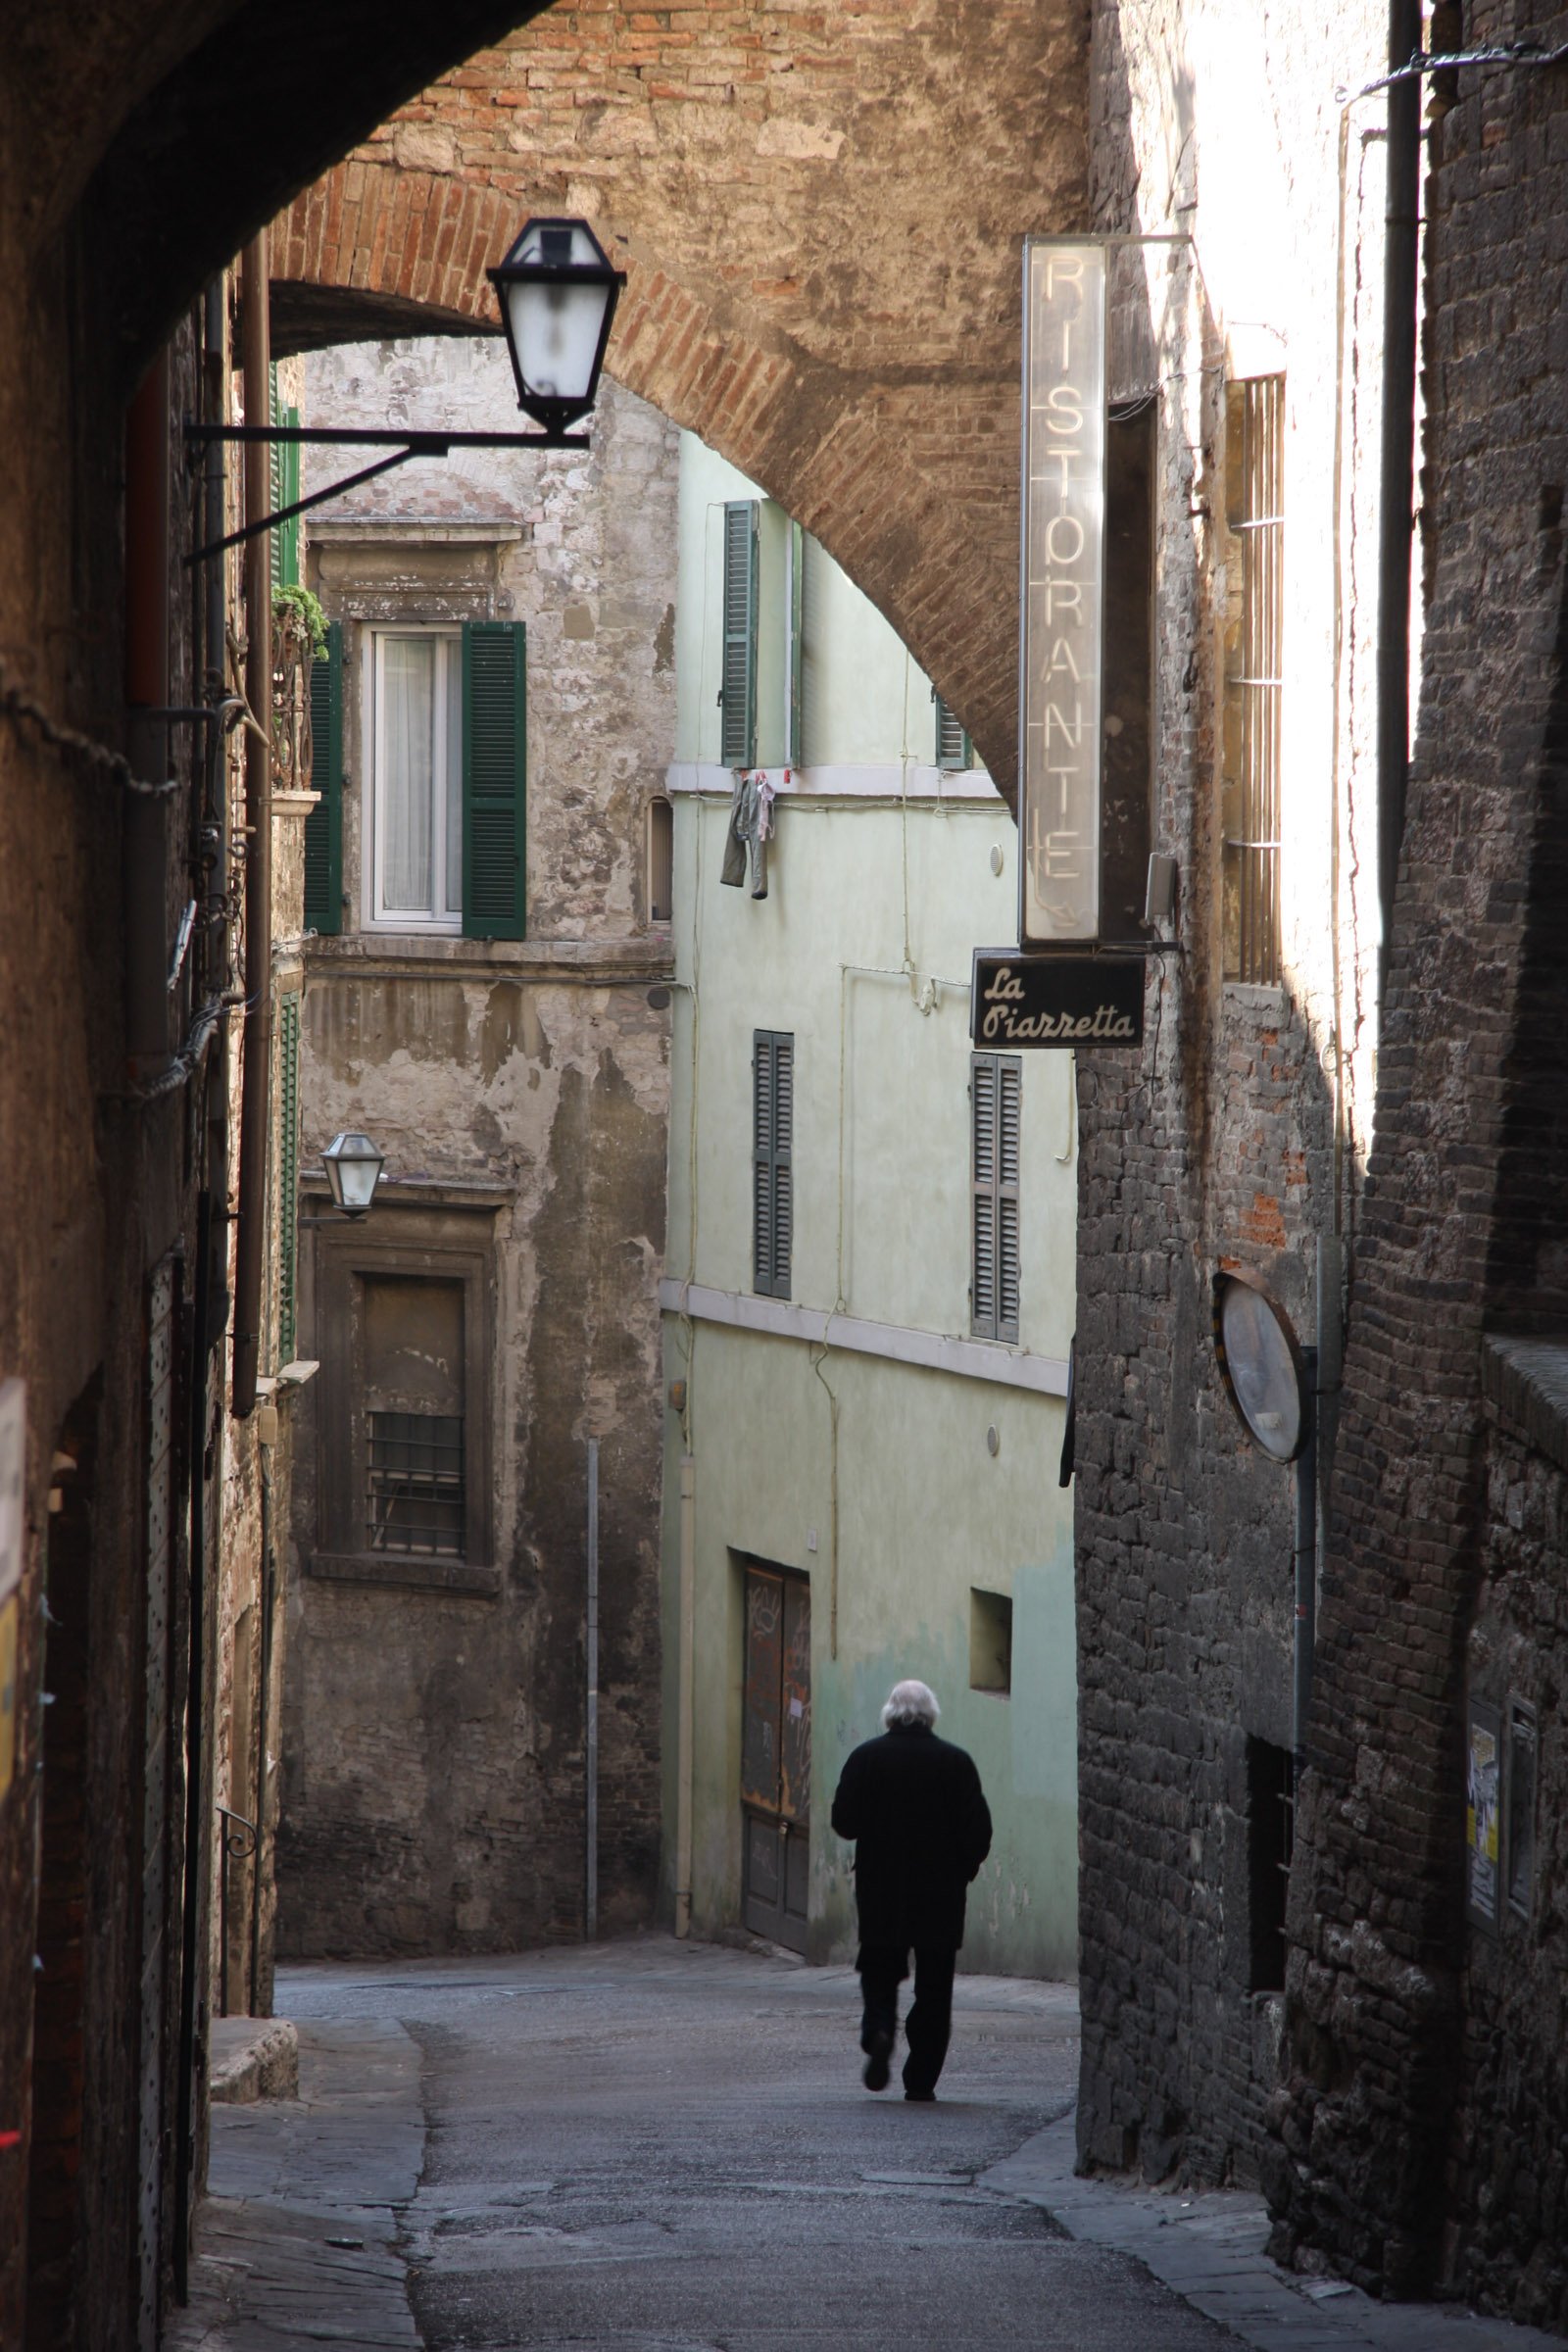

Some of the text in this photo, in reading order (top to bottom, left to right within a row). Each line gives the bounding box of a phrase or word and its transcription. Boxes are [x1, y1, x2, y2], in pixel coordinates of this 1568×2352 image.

[1044, 255, 1085, 878] RISTORANTE
[984, 967, 1025, 1000] La
[983, 1004, 1136, 1039] Piazzetta
